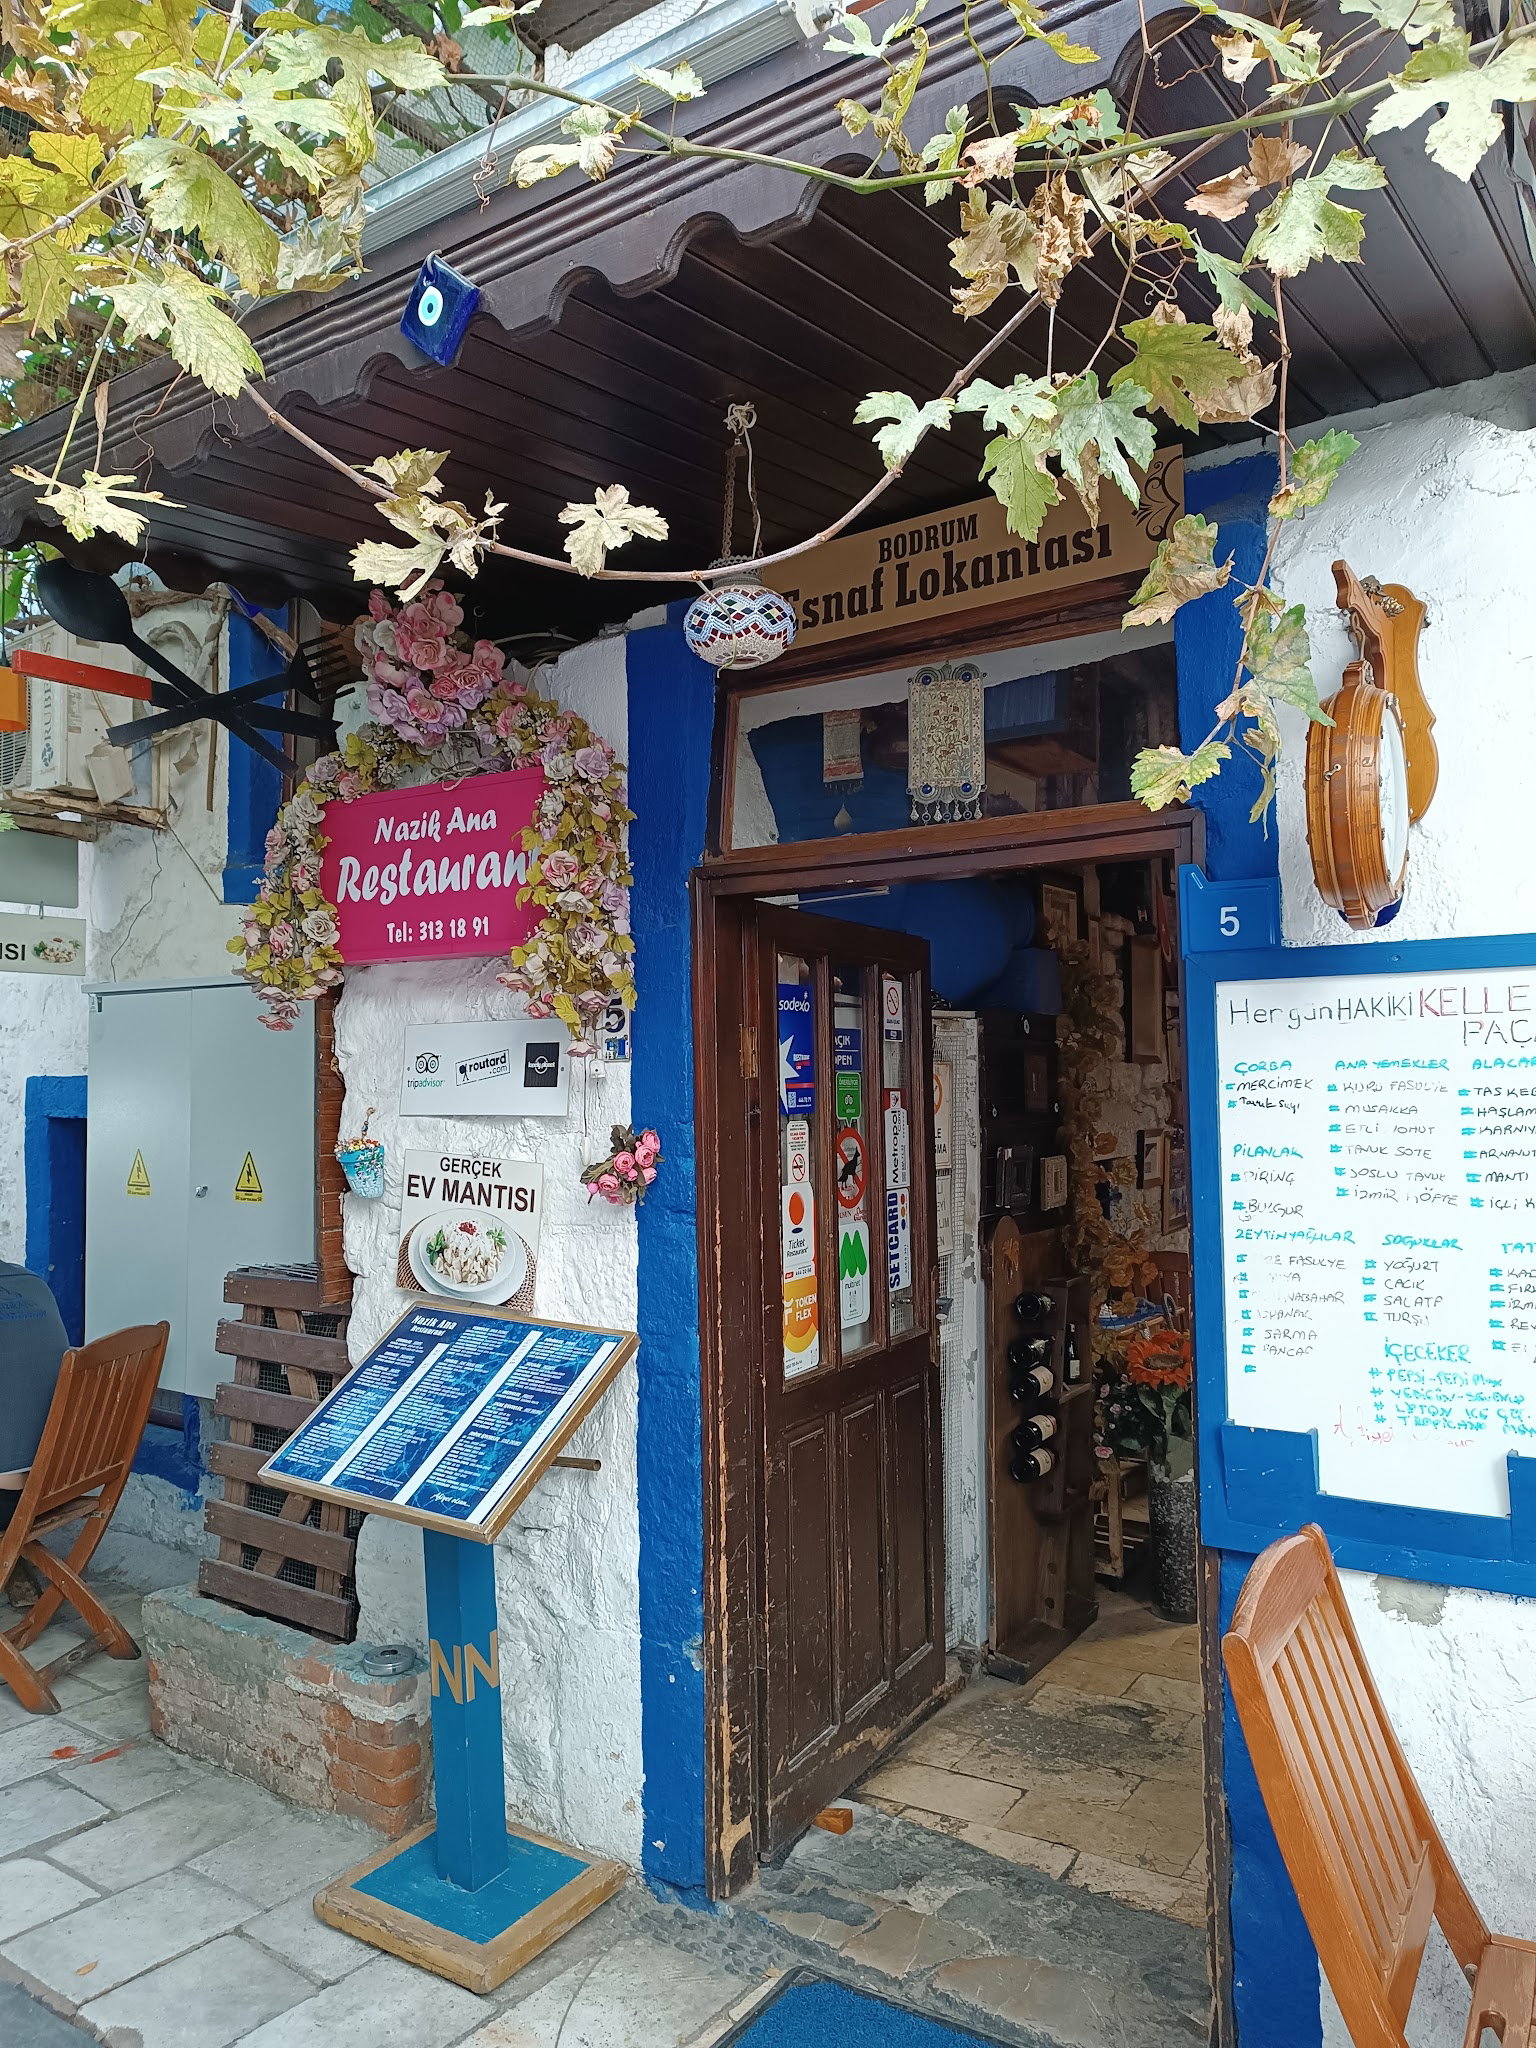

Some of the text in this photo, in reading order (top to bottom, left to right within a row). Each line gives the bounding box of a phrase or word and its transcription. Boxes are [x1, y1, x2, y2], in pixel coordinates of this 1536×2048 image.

[878, 513, 978, 564] BODRUM
[894, 523, 1112, 608] Lokantası
[373, 806, 498, 845] Nazik Ana
[387, 915, 489, 944] Tel: 313 18 91
[1220, 906, 1240, 937] 5
[605, 997, 626, 1033] 5
[778, 996, 810, 1012] sodexo
[1419, 984, 1531, 1017] KELLE
[1463, 1019, 1536, 1048] PAÇ
[468, 1052, 507, 1073] routard
[407, 1077, 444, 1090] tripadvisor
[1473, 1086, 1503, 1097] TAS
[891, 1110, 900, 1183] Metropol
[440, 1156, 502, 1179] GERÇEK
[1485, 1171, 1529, 1182] MANTI
[407, 1174, 535, 1213] EV MANTISI
[888, 1192, 901, 1289] SETCARD
[795, 1292, 817, 1309] TOKEN
[795, 1306, 812, 1322] FLEX
